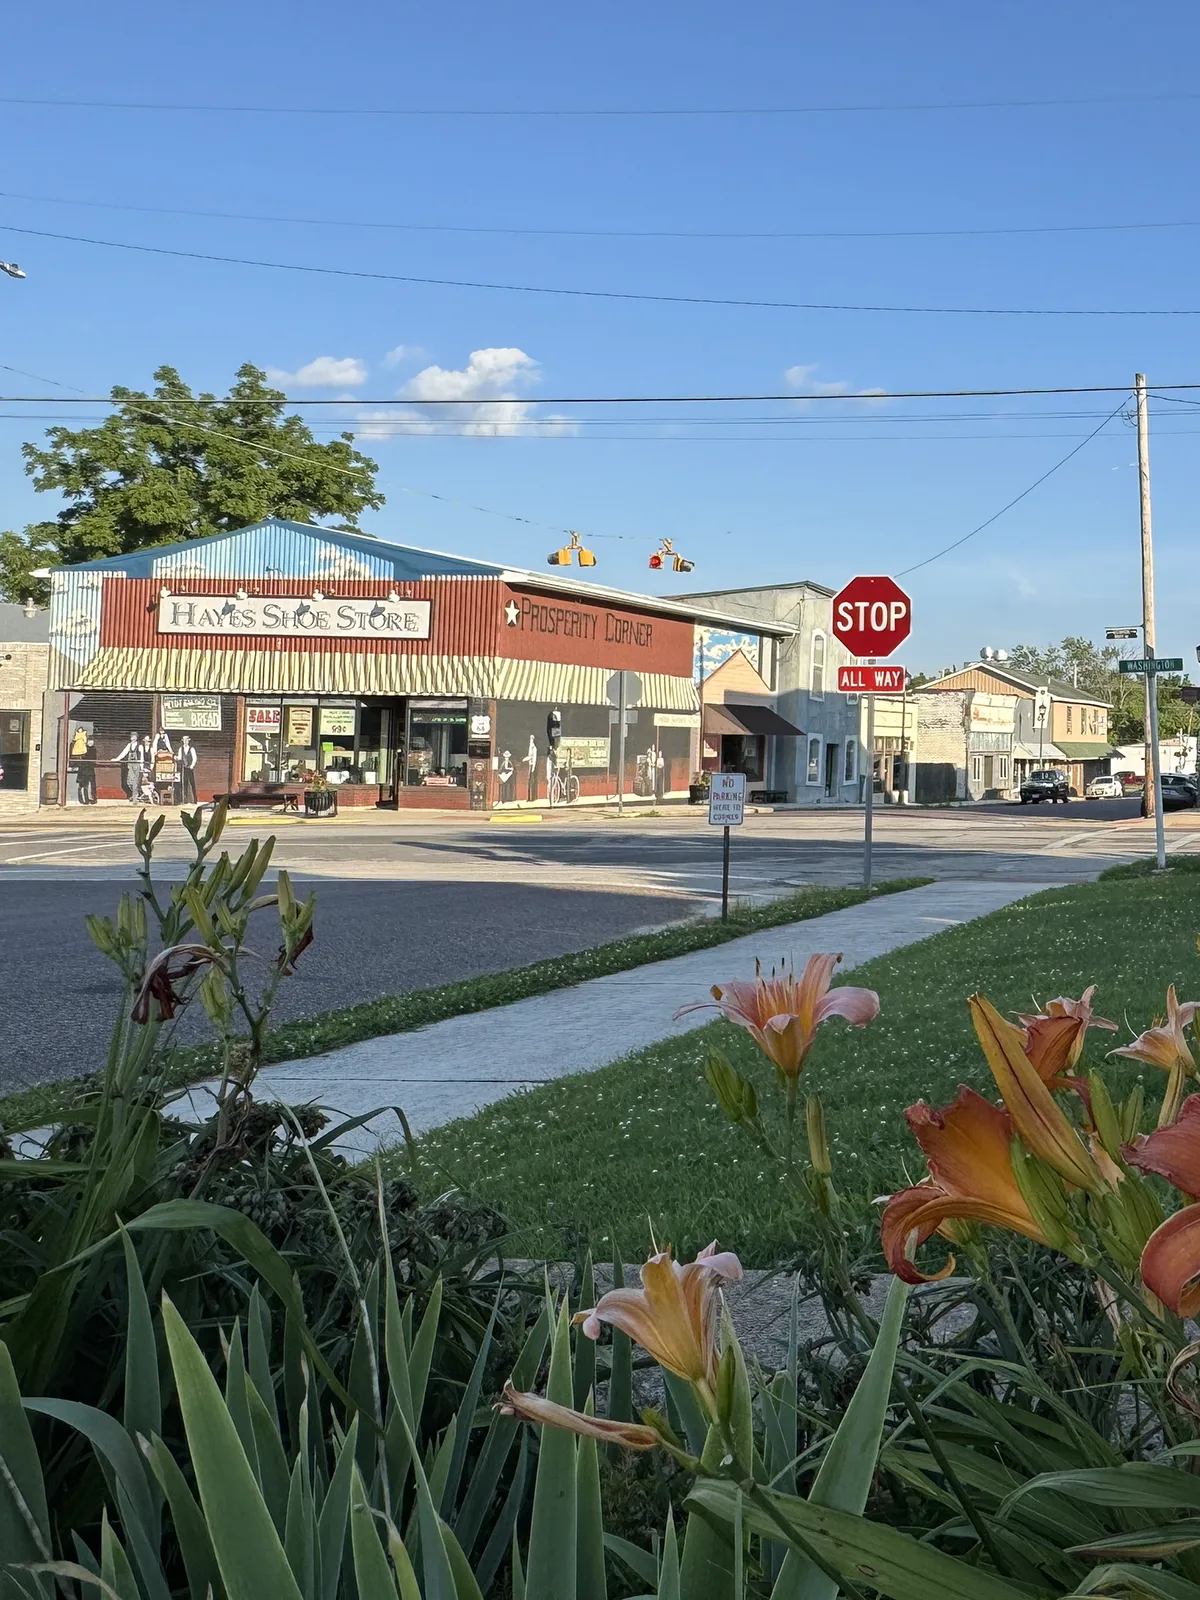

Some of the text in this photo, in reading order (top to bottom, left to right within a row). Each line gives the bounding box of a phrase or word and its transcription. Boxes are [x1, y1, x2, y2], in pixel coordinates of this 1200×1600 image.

[171, 602, 419, 632] HAYES SHOE STORE
[521, 597, 653, 648] PROSPERITY CORNER
[836, 601, 907, 632] STOP
[1127, 660, 1175, 671] WASHINGTON
[841, 671, 900, 687] ALL WAY
[191, 712, 219, 727] BREAD
[249, 709, 280, 723] SALE
[722, 779, 734, 788] NO
[713, 792, 743, 801] PARKING
